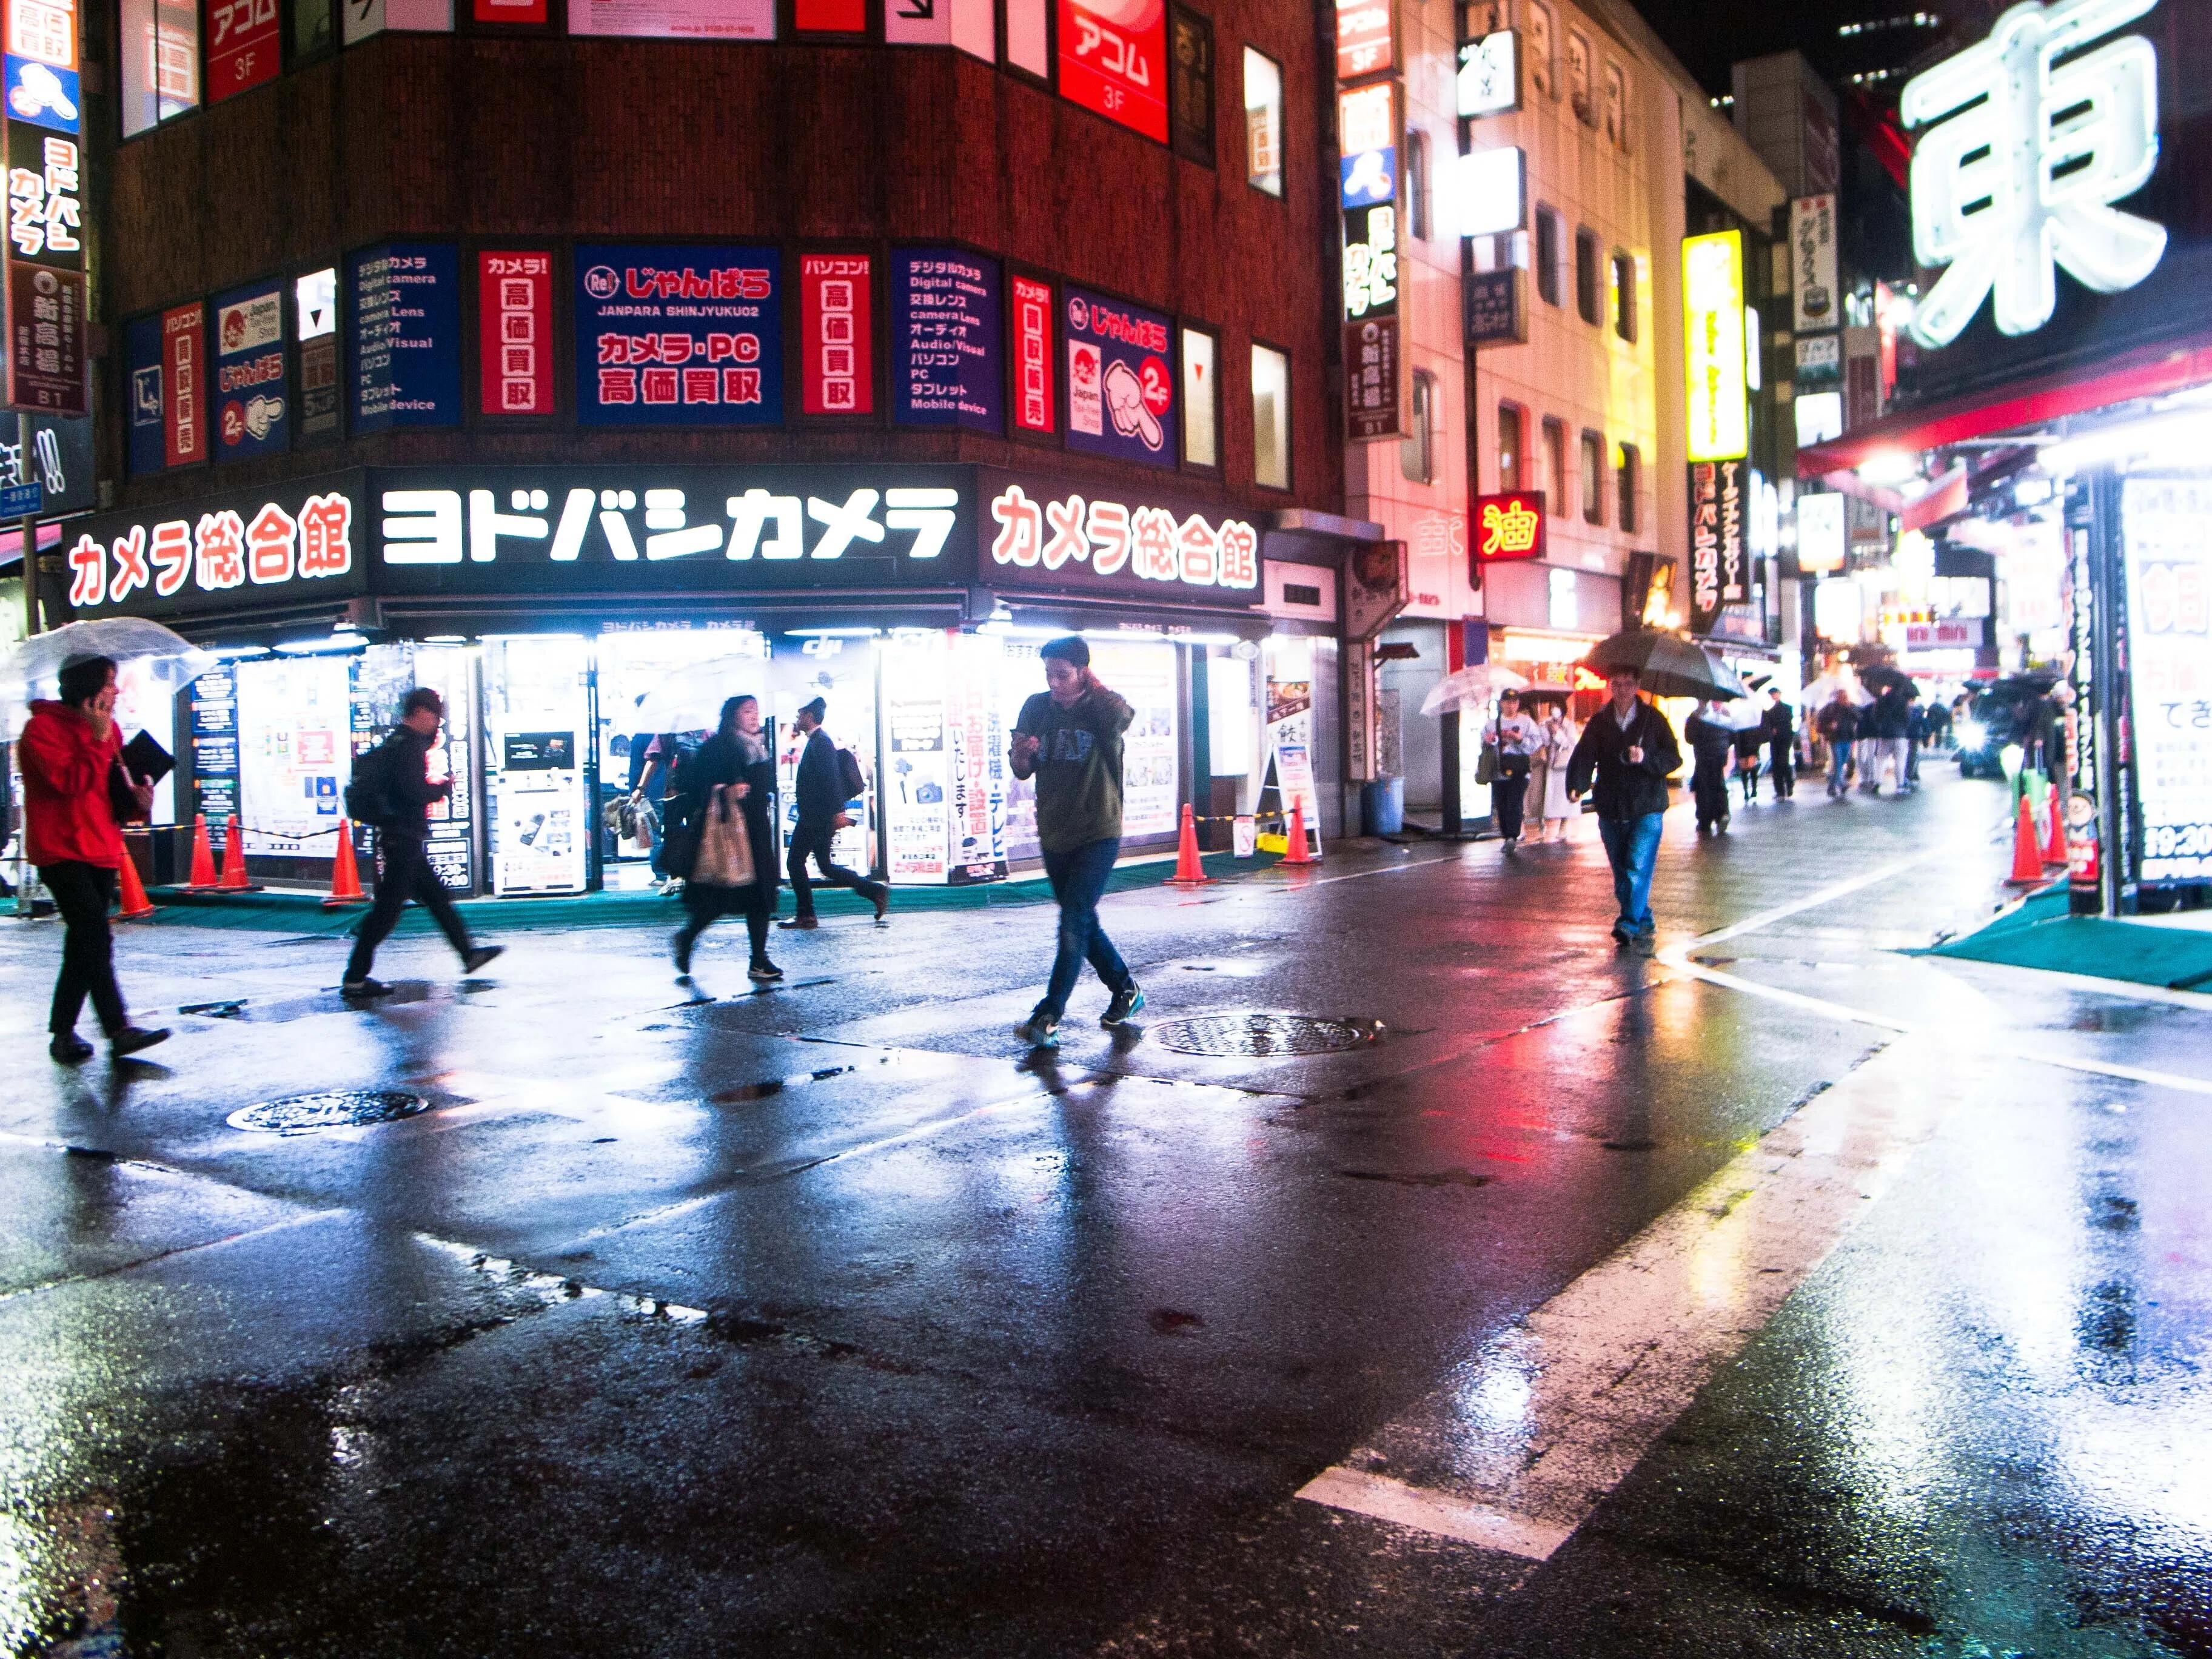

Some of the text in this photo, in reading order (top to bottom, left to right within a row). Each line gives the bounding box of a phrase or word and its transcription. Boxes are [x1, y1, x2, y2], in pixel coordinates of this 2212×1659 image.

[213, 0, 276, 45] アコム
[235, 52, 255, 81] 3F
[1075, 14, 1150, 88] アコム
[1103, 84, 1124, 111] 3F
[1901, 0, 2167, 350] 東
[44, 136, 80, 252] ヨドバシ
[9, 168, 45, 255] カメラ
[625, 267, 770, 299] じゃんぱら
[805, 260, 870, 275] パソコン!
[910, 261, 981, 281] デジタルカメラ
[910, 277, 951, 288] Digital
[391, 306, 425, 317] Lens
[598, 305, 759, 317] JANPARA SHINJYUKU02
[910, 310, 958, 320] camera
[500, 278, 535, 409] 高価買取
[820, 280, 855, 409] 高価買取
[910, 323, 967, 338] オーディオ
[1091, 304, 1167, 353] じゃんぱら
[597, 333, 760, 364] カメラ・PC
[910, 353, 959, 366] パソコン
[599, 367, 762, 404] 高価買取
[910, 383, 967, 397] タブレット
[911, 369, 928, 380] PC
[1143, 367, 1168, 404] 2F
[911, 399, 955, 409] Mobile
[225, 411, 243, 436] 2F
[383, 488, 958, 563] ヨドバシカメラ
[991, 485, 1257, 589] カメラ総合館
[1483, 501, 1538, 554] 油
[1694, 463, 1717, 611] ヨドバシカメラ
[69, 492, 351, 606] カメラ総合館
